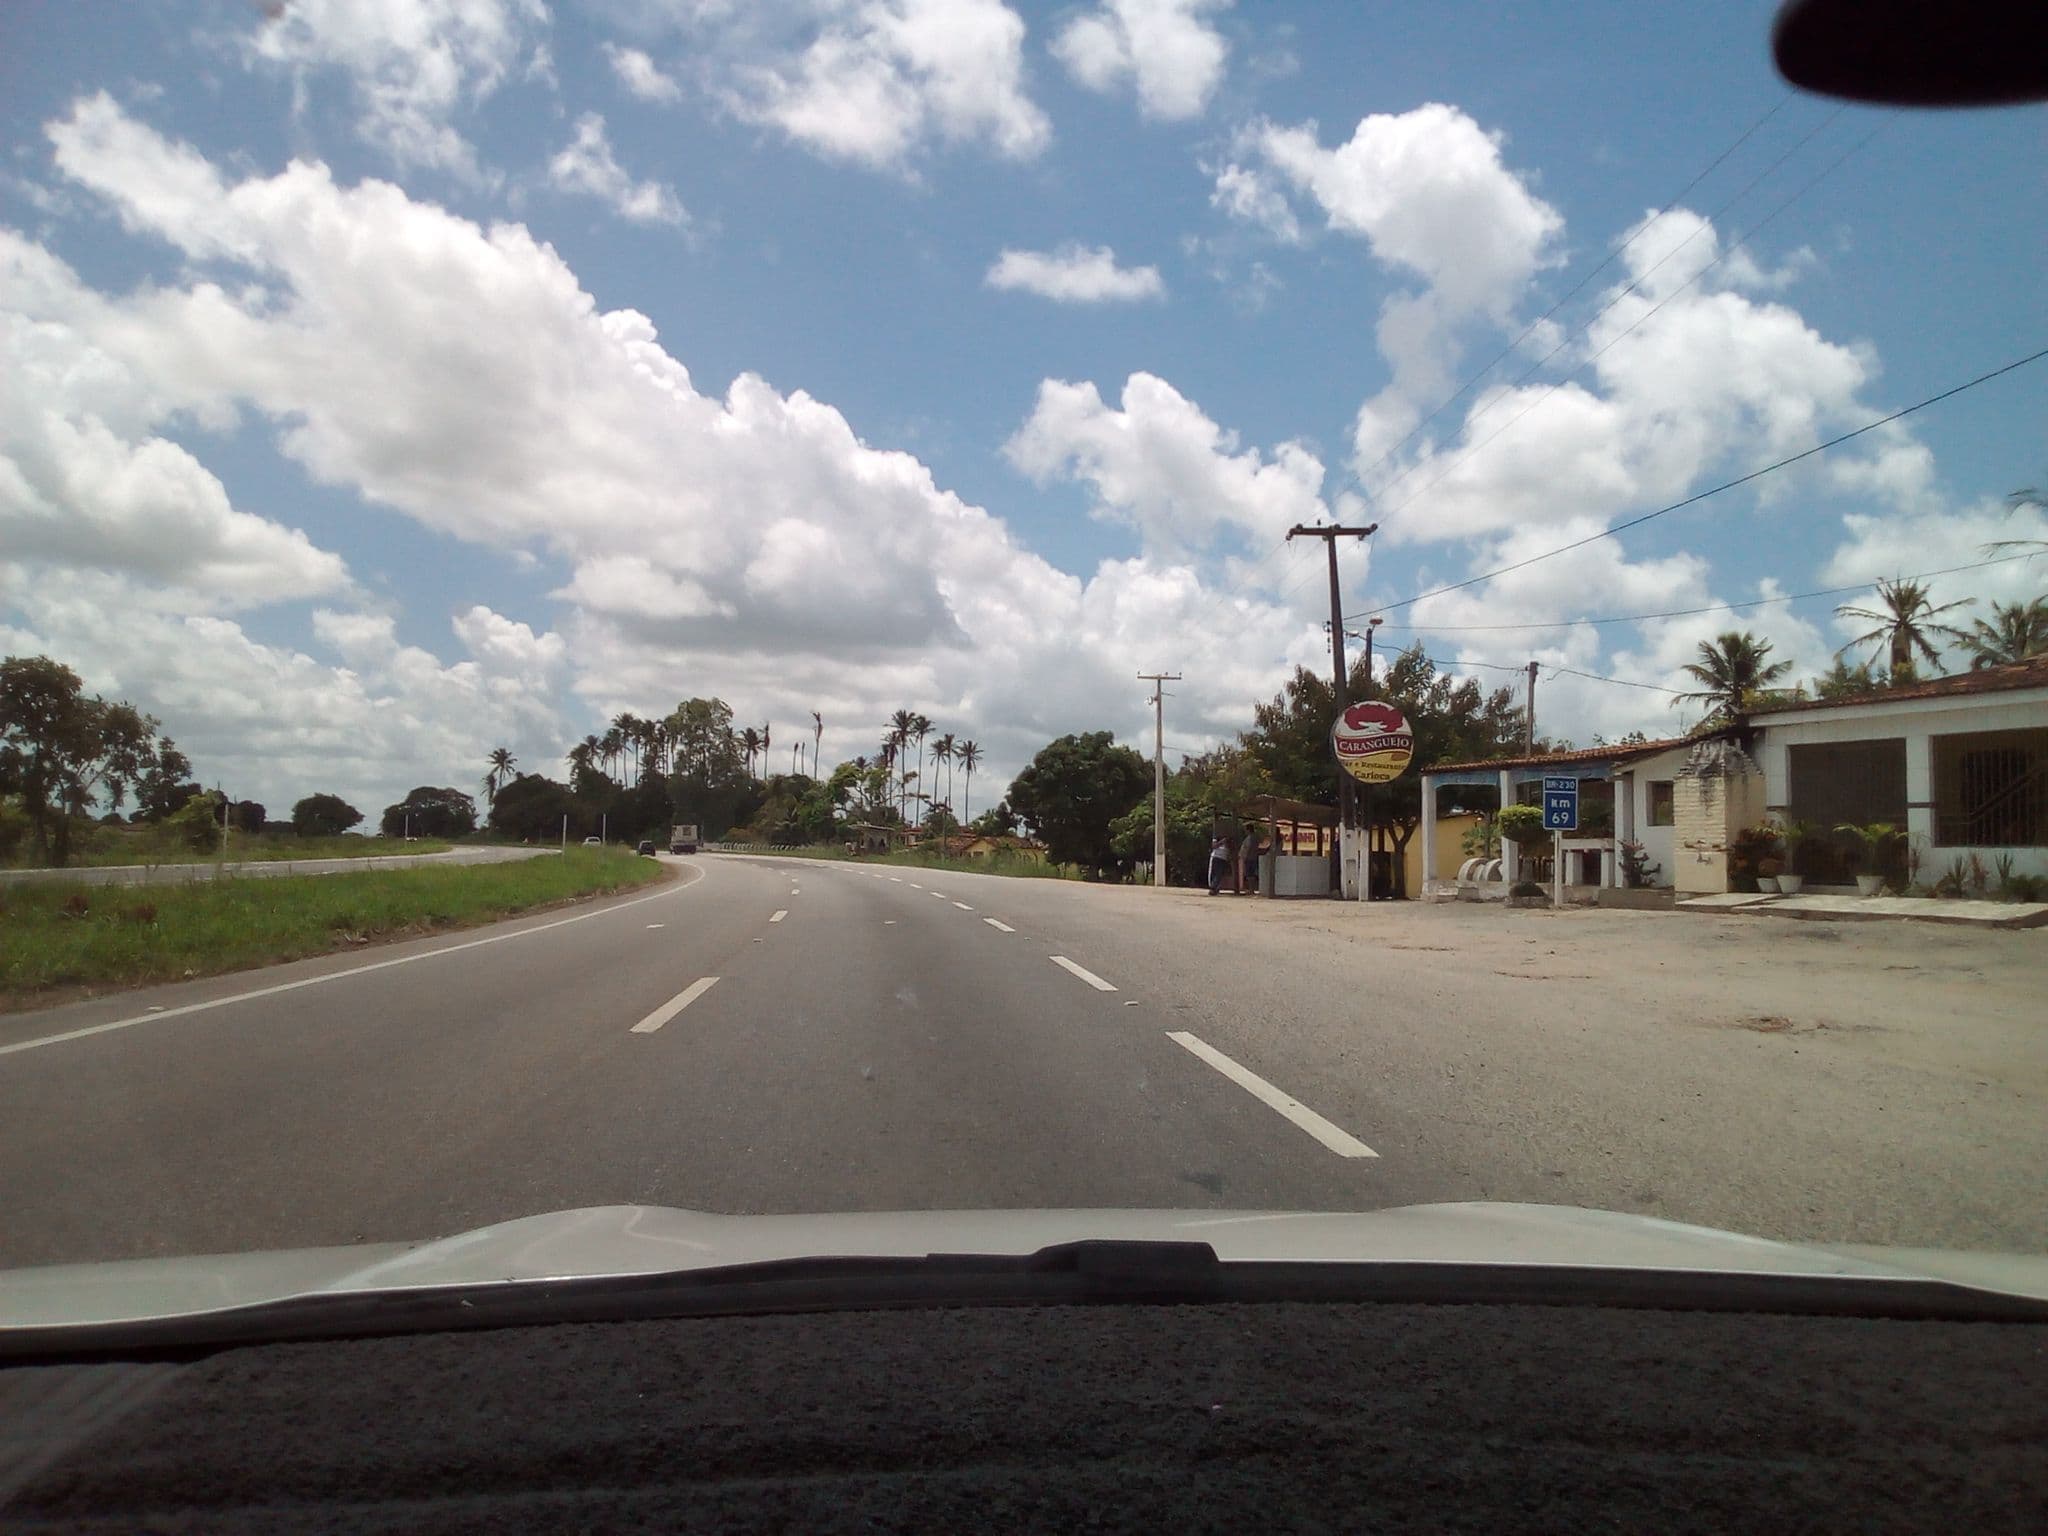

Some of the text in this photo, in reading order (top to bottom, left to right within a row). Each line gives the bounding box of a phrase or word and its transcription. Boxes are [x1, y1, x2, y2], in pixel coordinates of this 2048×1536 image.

[1339, 737, 1409, 752] CARANGUEJO
[1354, 770, 1390, 780] Carioca
[1546, 780, 1575, 789] BR-230
[1552, 812, 1569, 824] 69
